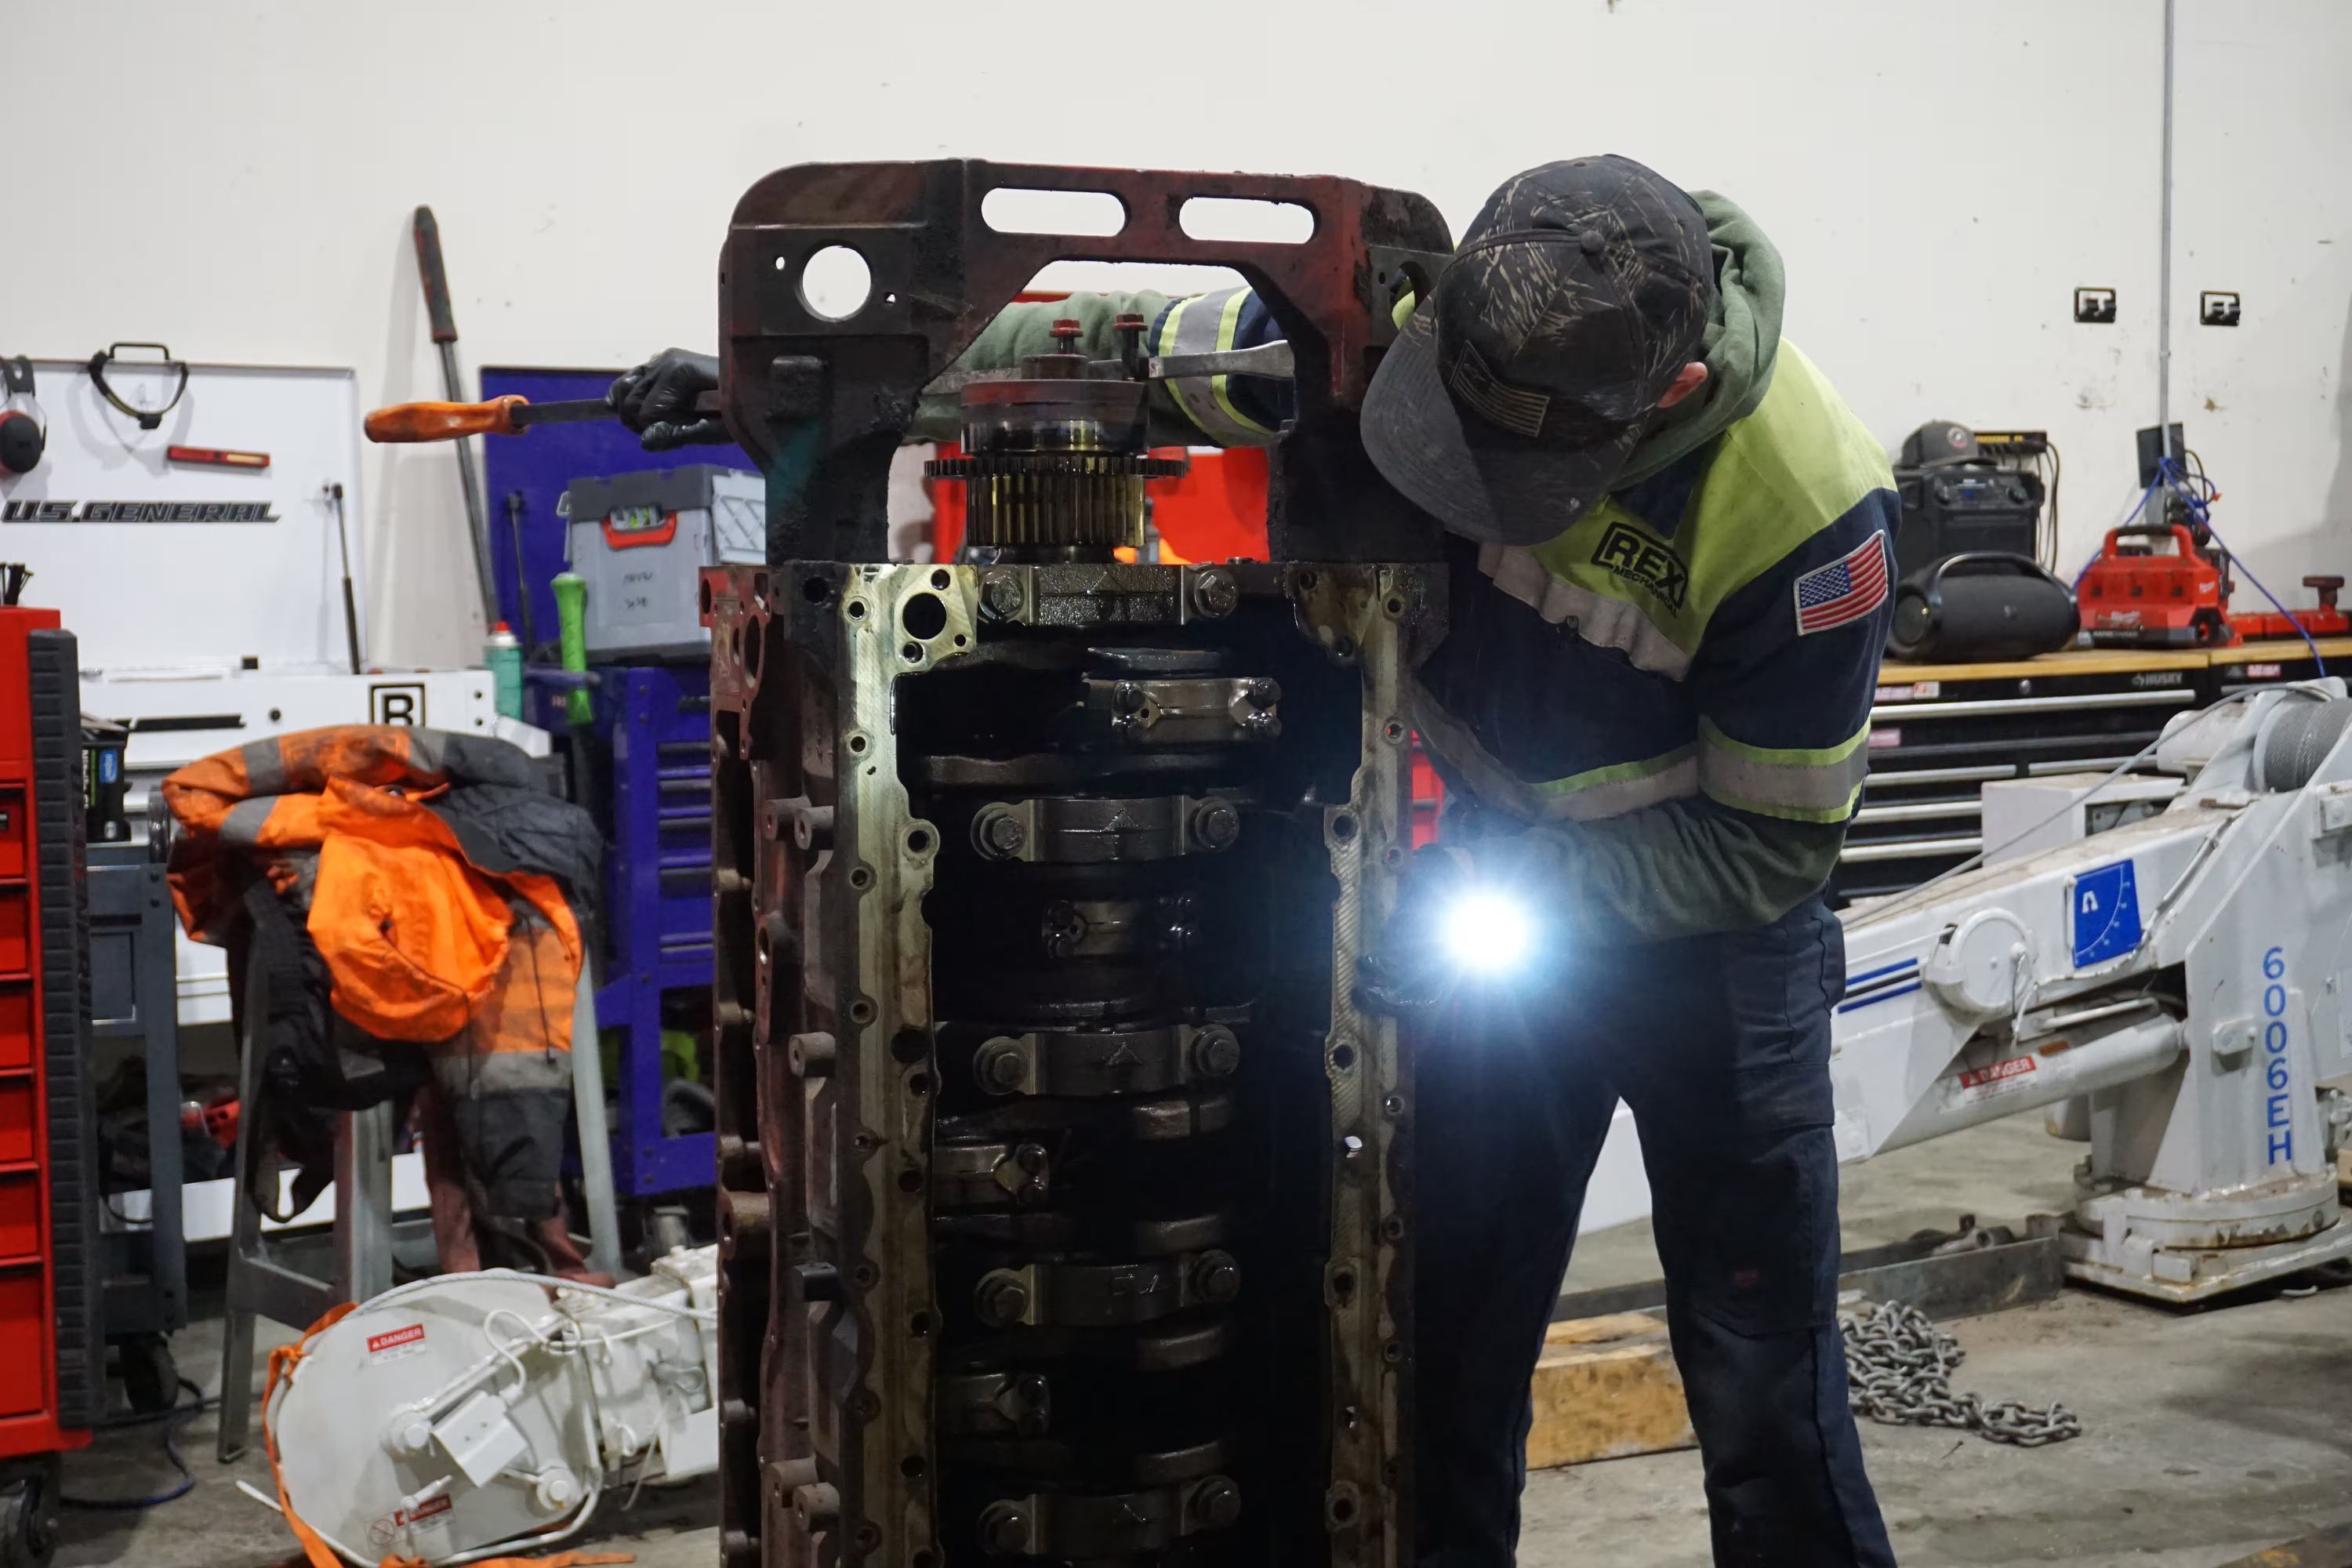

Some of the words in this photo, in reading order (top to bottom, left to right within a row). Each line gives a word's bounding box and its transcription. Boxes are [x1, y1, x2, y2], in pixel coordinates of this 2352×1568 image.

[80, 500, 282, 523] GENERAL
[1603, 531, 1685, 606] REX
[1613, 565, 1677, 619] MECHANICAL
[2144, 672, 2182, 685] HUSKY
[2263, 946, 2292, 1165] 6006EH
[1979, 1058, 2031, 1080] DANGER
[380, 1327, 421, 1345] DANGER
